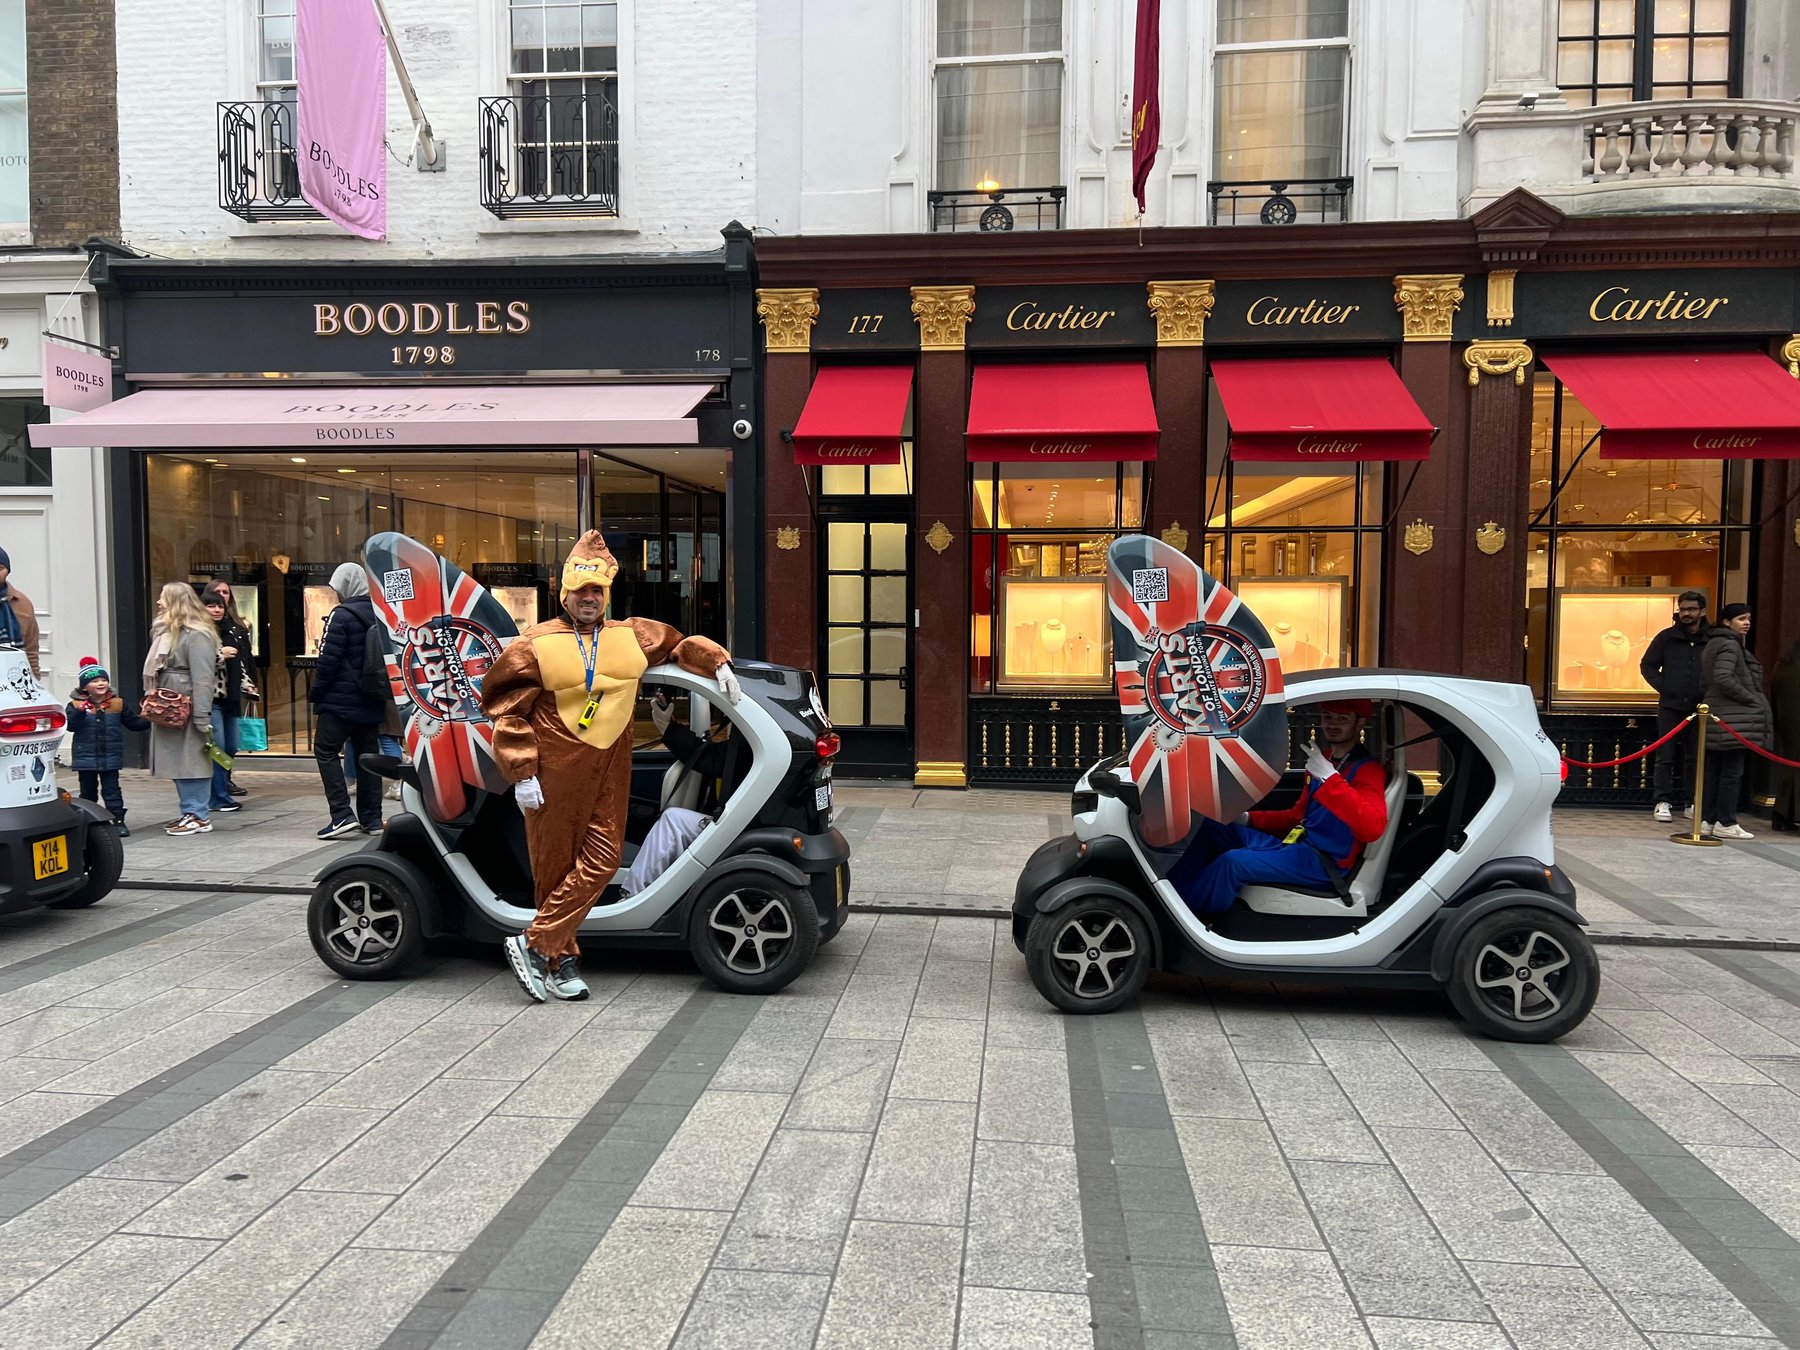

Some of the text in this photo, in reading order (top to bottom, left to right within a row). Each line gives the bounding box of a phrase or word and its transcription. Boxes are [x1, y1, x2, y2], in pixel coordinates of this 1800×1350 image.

[1246, 295, 1360, 326] Cartier
[1588, 285, 1729, 322] Cartier
[312, 300, 531, 336] BOODLES
[848, 315, 884, 334] 177
[1006, 301, 1116, 331] Cartier
[391, 345, 455, 365] 1798
[695, 350, 721, 362] 178
[55, 365, 104, 388] BOODLES
[73, 384, 89, 393] 1798
[283, 402, 501, 414] BOODLES
[315, 427, 395, 440] BOODLES
[1692, 433, 1763, 450] Cartier
[817, 440, 878, 458] Cartier
[1029, 439, 1092, 455] Cartier
[1297, 436, 1363, 454] Cartier
[409, 627, 467, 720] KARTS
[433, 628, 468, 699] OF LONDON
[1186, 635, 1216, 712] OF LONDON
[1159, 633, 1212, 733] KARTS
[1195, 636, 1227, 722] THE ULTIMATE DRIVING TOUR
[13, 742, 39, 756] 07436
[41, 840, 60, 859] Y14
[40, 856, 63, 876] KOL
